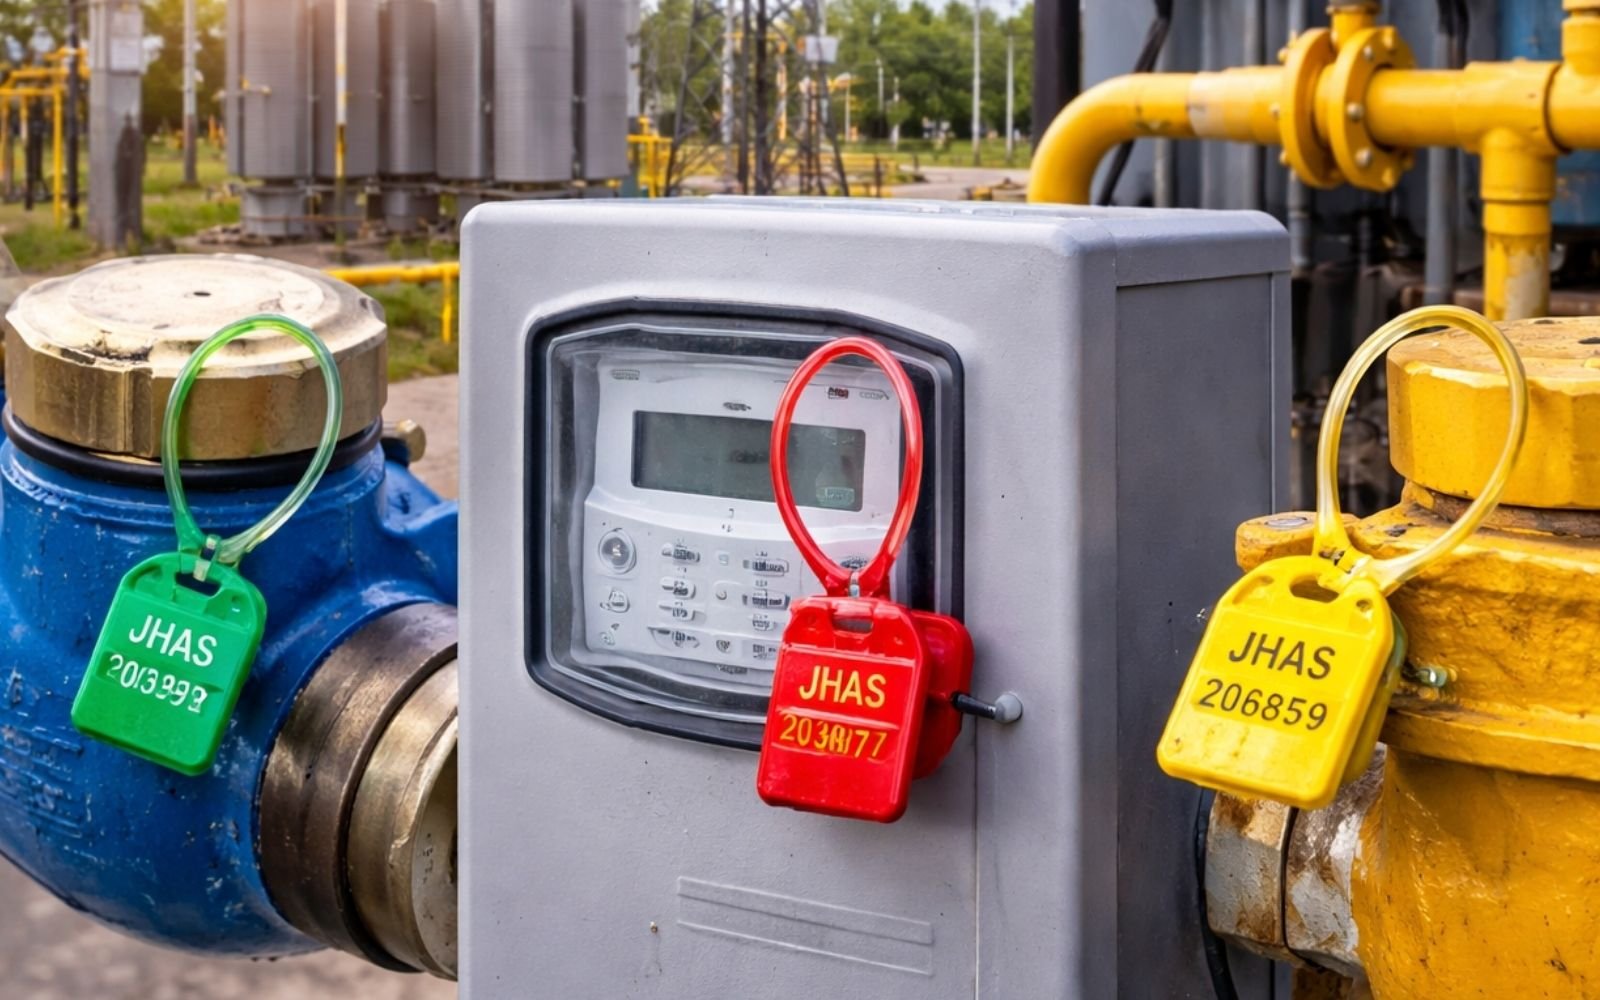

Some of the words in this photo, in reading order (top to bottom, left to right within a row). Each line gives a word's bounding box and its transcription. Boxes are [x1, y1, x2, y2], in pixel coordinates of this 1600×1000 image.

[128, 615, 217, 667] JHAS
[1228, 632, 1336, 680] JHAS
[799, 665, 886, 708] JHAS
[1199, 679, 1327, 730] 206859
